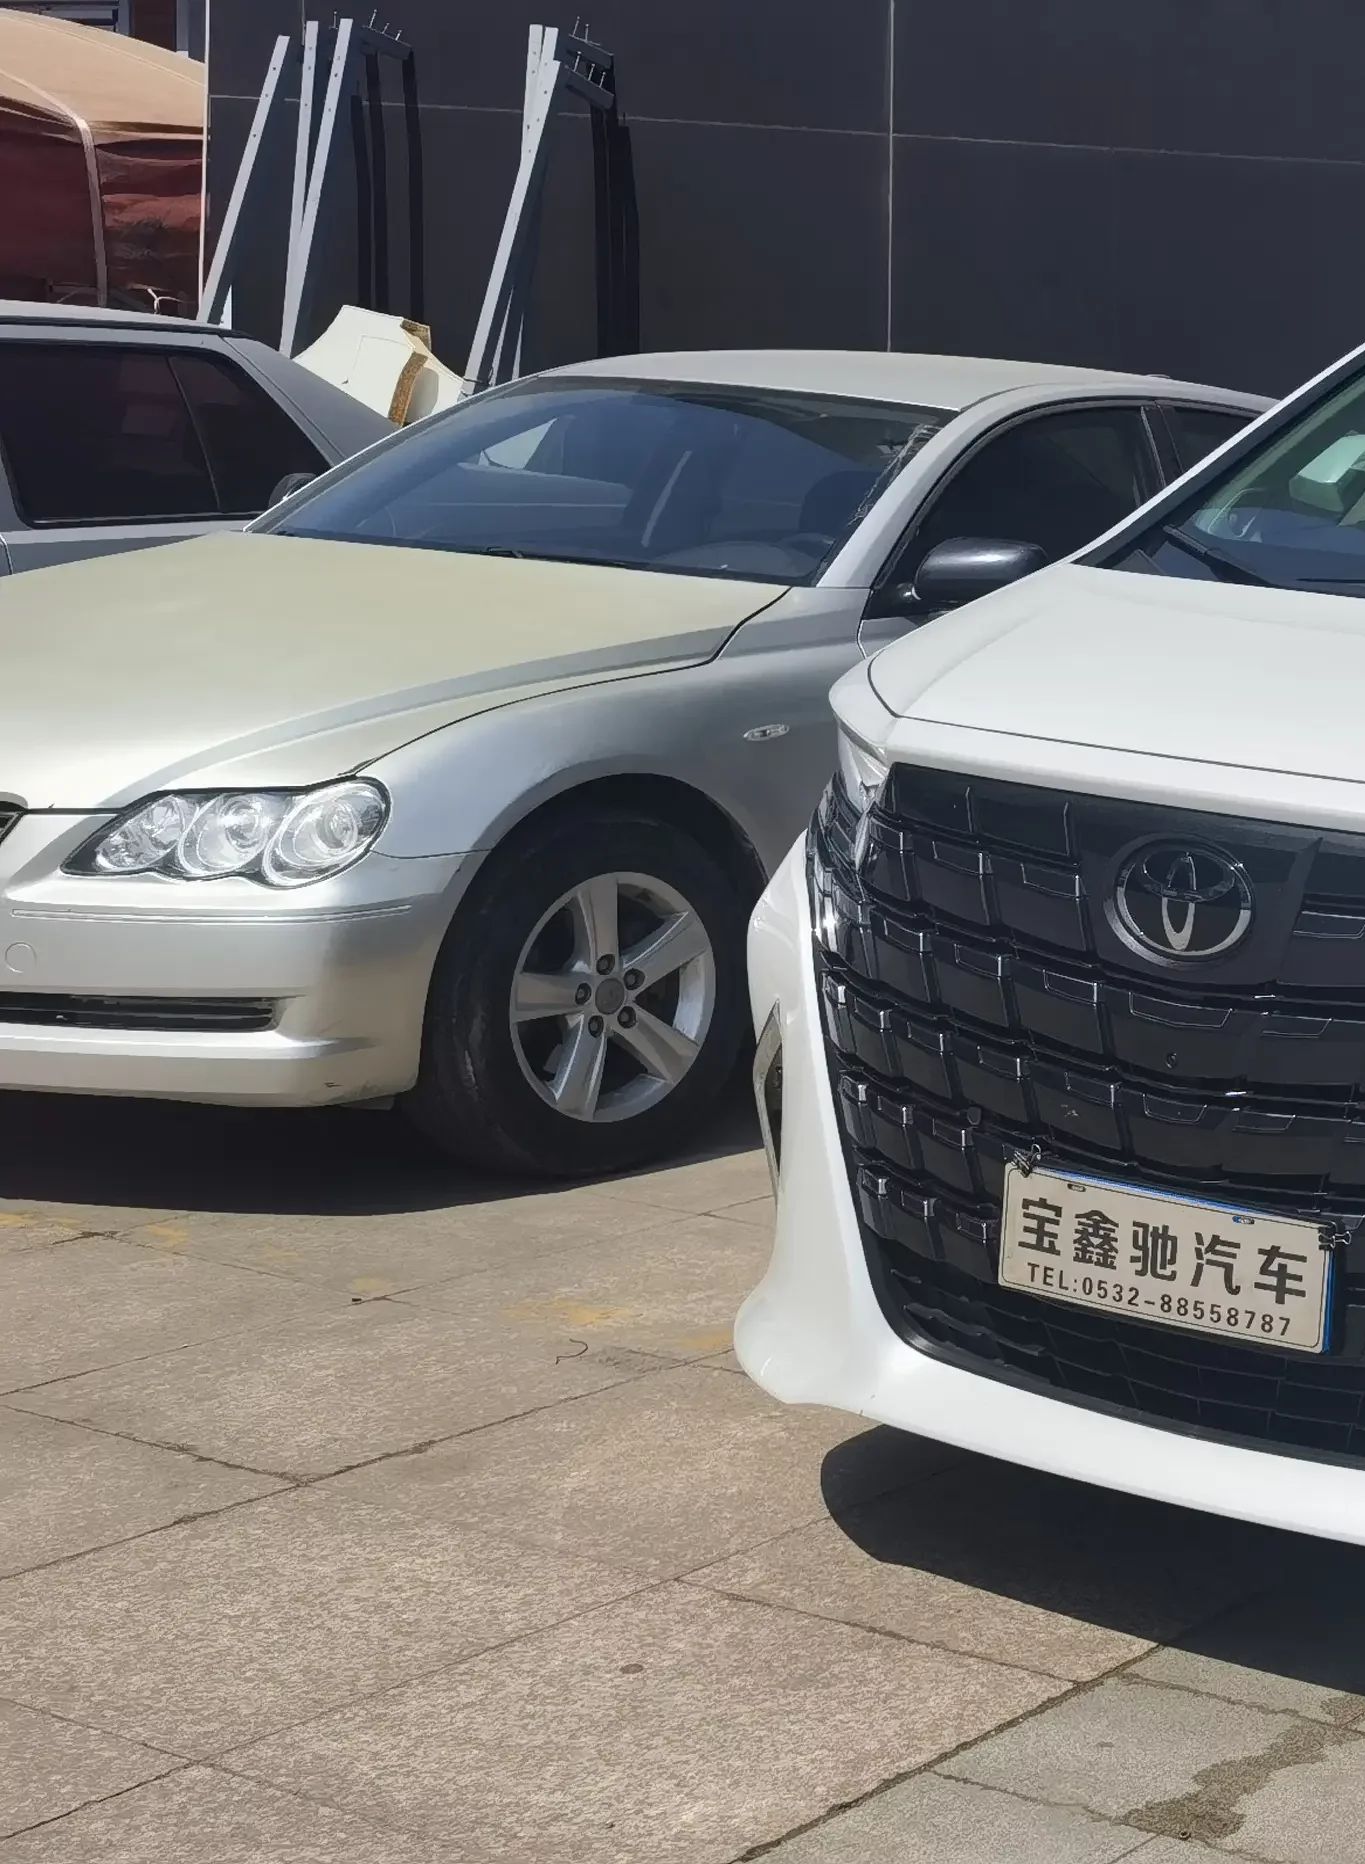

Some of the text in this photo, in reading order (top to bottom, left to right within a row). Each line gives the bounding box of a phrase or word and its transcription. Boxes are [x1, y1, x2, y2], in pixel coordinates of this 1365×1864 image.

[1018, 1197, 1307, 1305] 宝鑫驰汽车
[1027, 1262, 1291, 1336] TEL:0532-88558787
